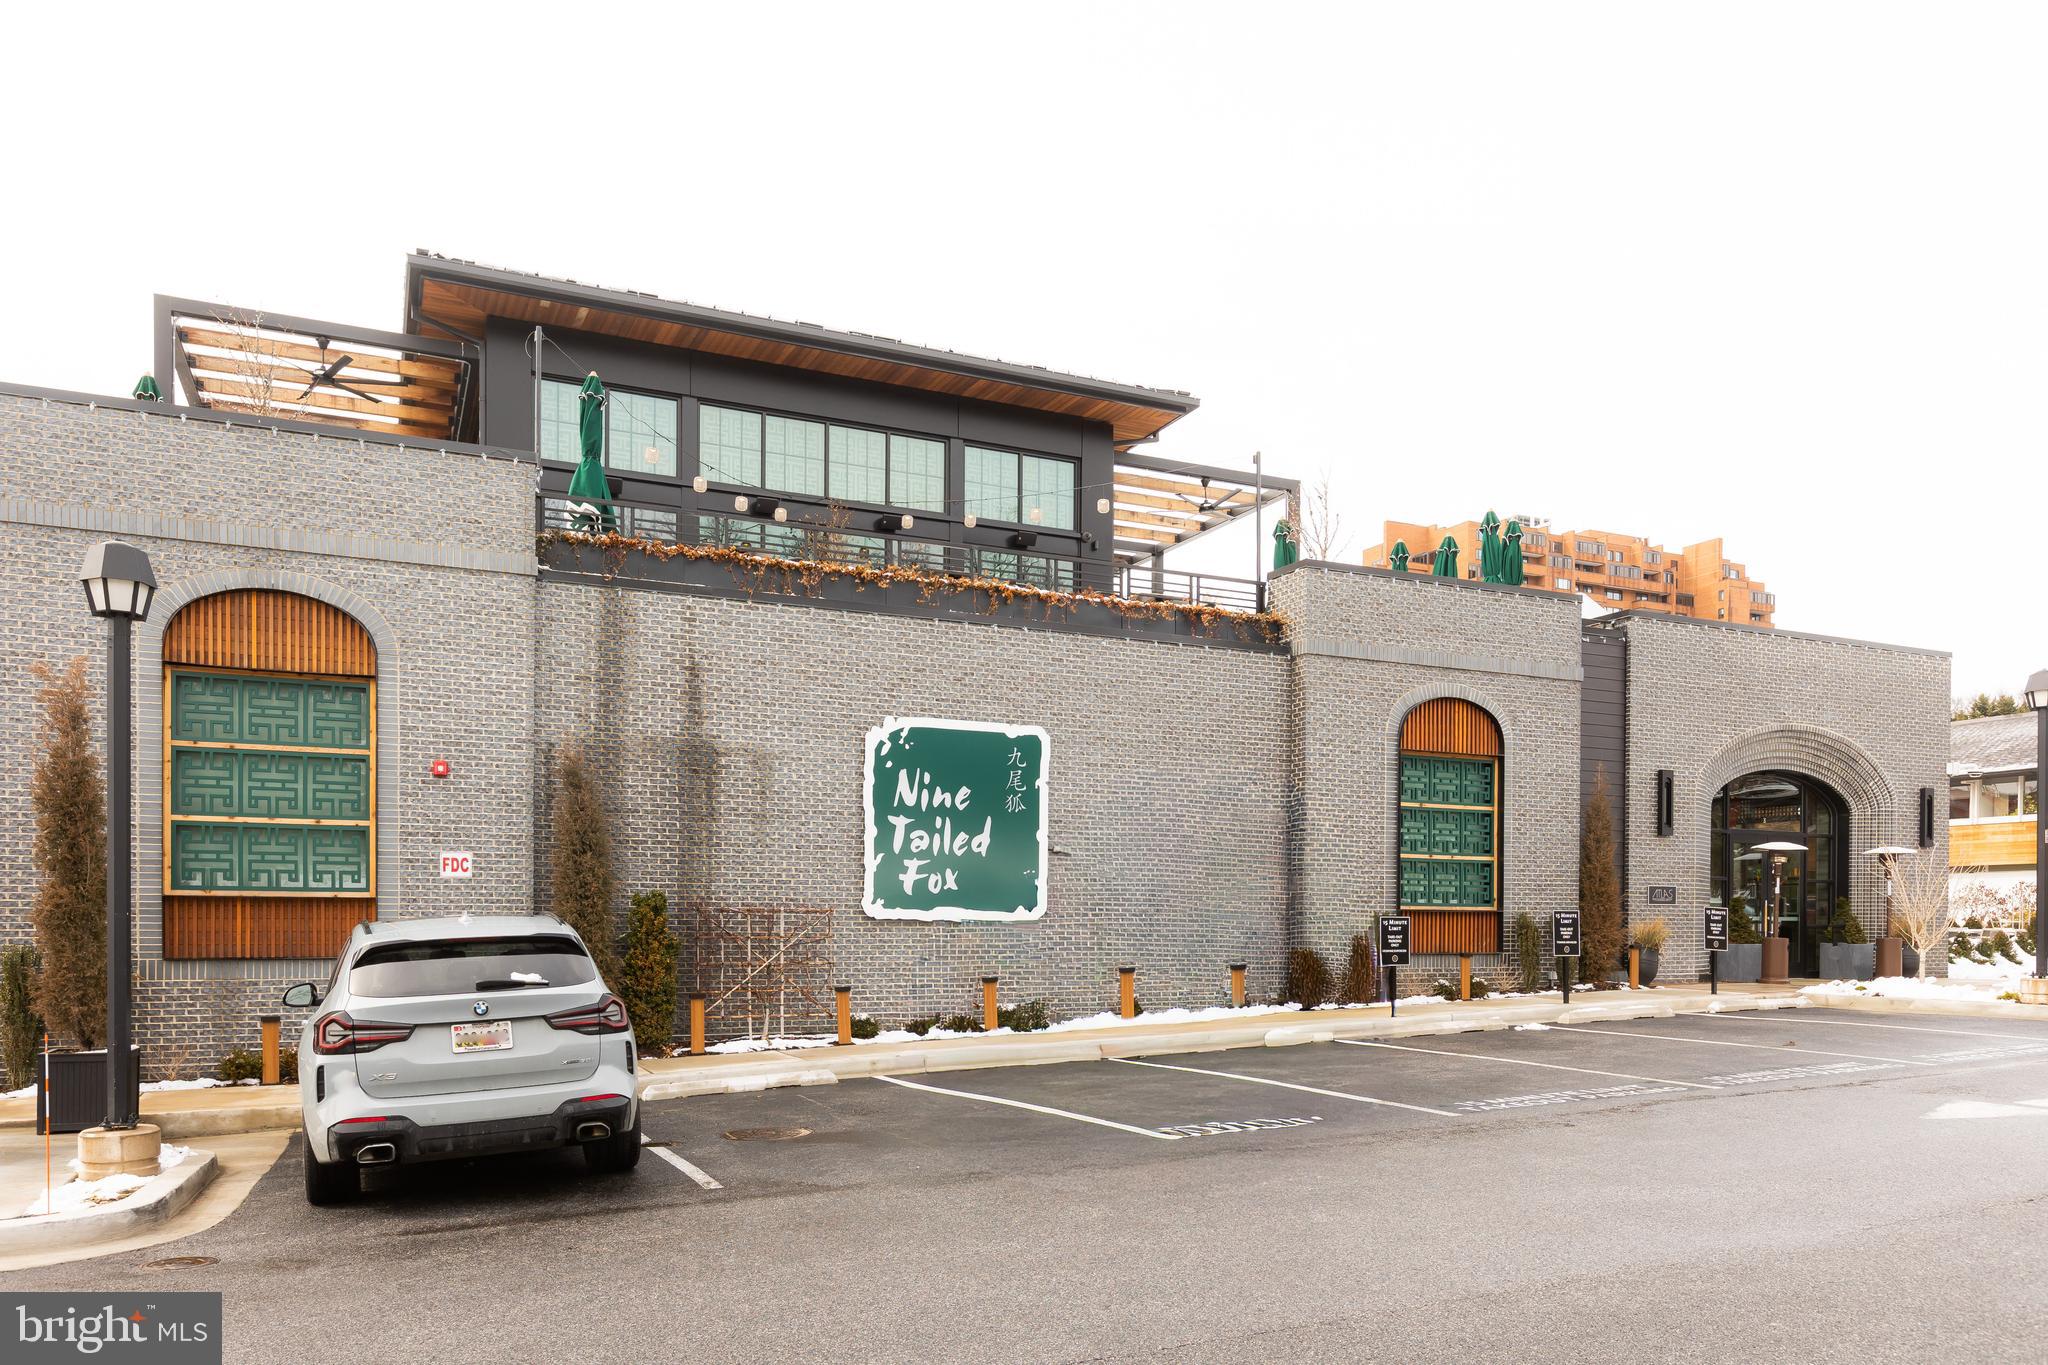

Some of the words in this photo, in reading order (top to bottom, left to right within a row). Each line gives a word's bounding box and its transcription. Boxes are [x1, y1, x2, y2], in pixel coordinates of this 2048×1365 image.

[893, 767, 971, 812] Nine
[1004, 746, 1027, 813] 九尾狐
[887, 814, 992, 857] Tailed
[442, 857, 469, 872] FDC
[898, 857, 959, 896] Fox
[369, 1072, 398, 1082] X3
